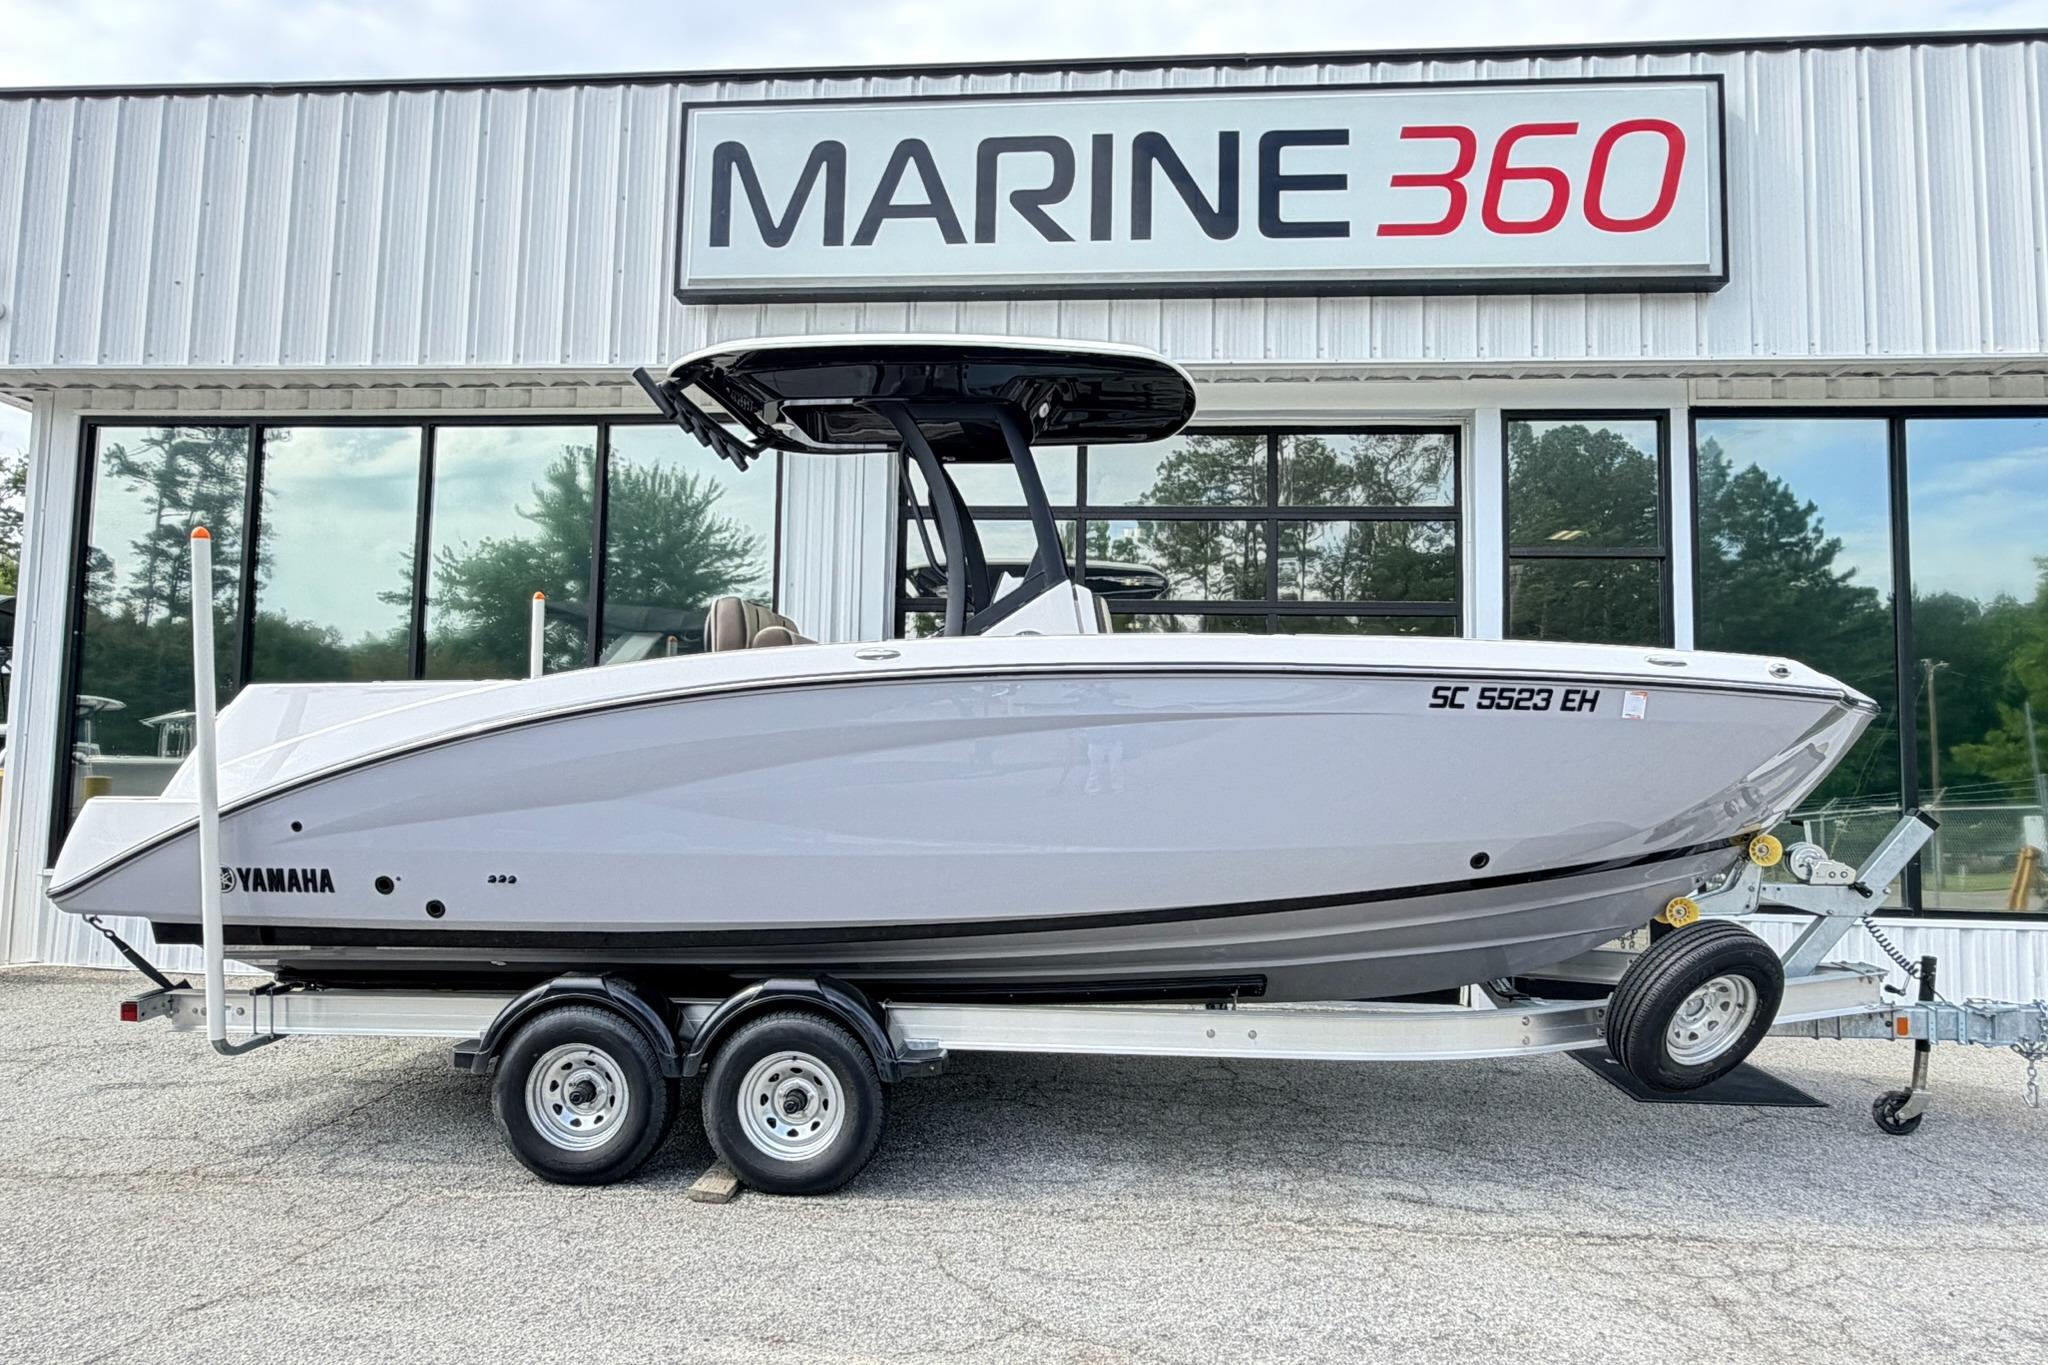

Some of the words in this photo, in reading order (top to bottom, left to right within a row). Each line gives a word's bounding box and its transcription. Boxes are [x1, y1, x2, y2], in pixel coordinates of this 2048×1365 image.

[709, 129, 1350, 248] MARINE
[1376, 119, 1686, 237] 360
[1429, 686, 1469, 709] SC
[1476, 687, 1553, 711] 5523
[1560, 689, 1600, 712] EH
[236, 867, 335, 893] YAMAHA
